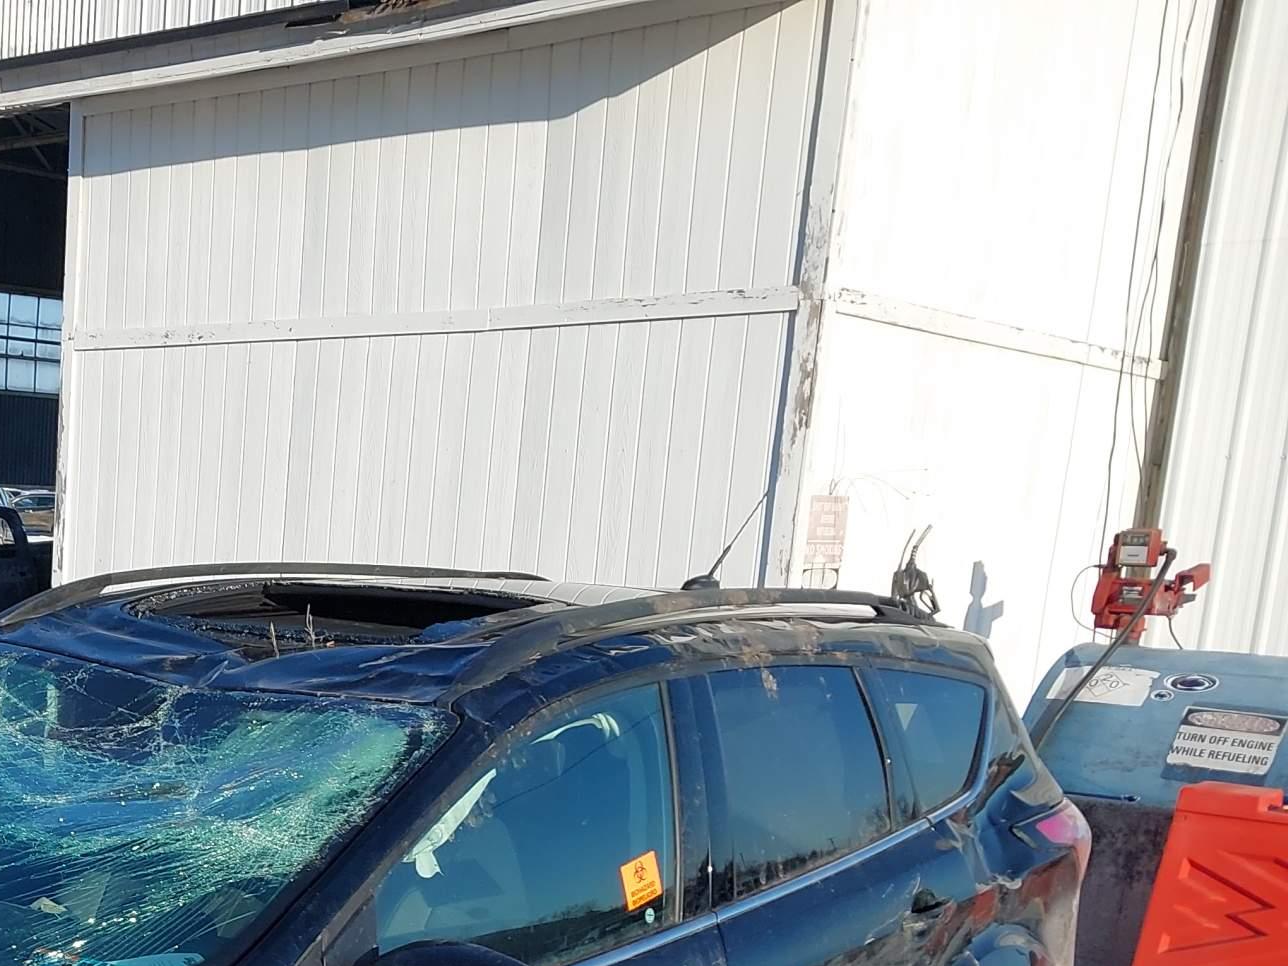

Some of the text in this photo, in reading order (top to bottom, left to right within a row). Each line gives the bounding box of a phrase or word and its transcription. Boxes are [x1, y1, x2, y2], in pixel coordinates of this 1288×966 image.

[1177, 731, 1274, 752] TURN OFF ENGINE
[1170, 746, 1269, 766] WHILE REFUELING
